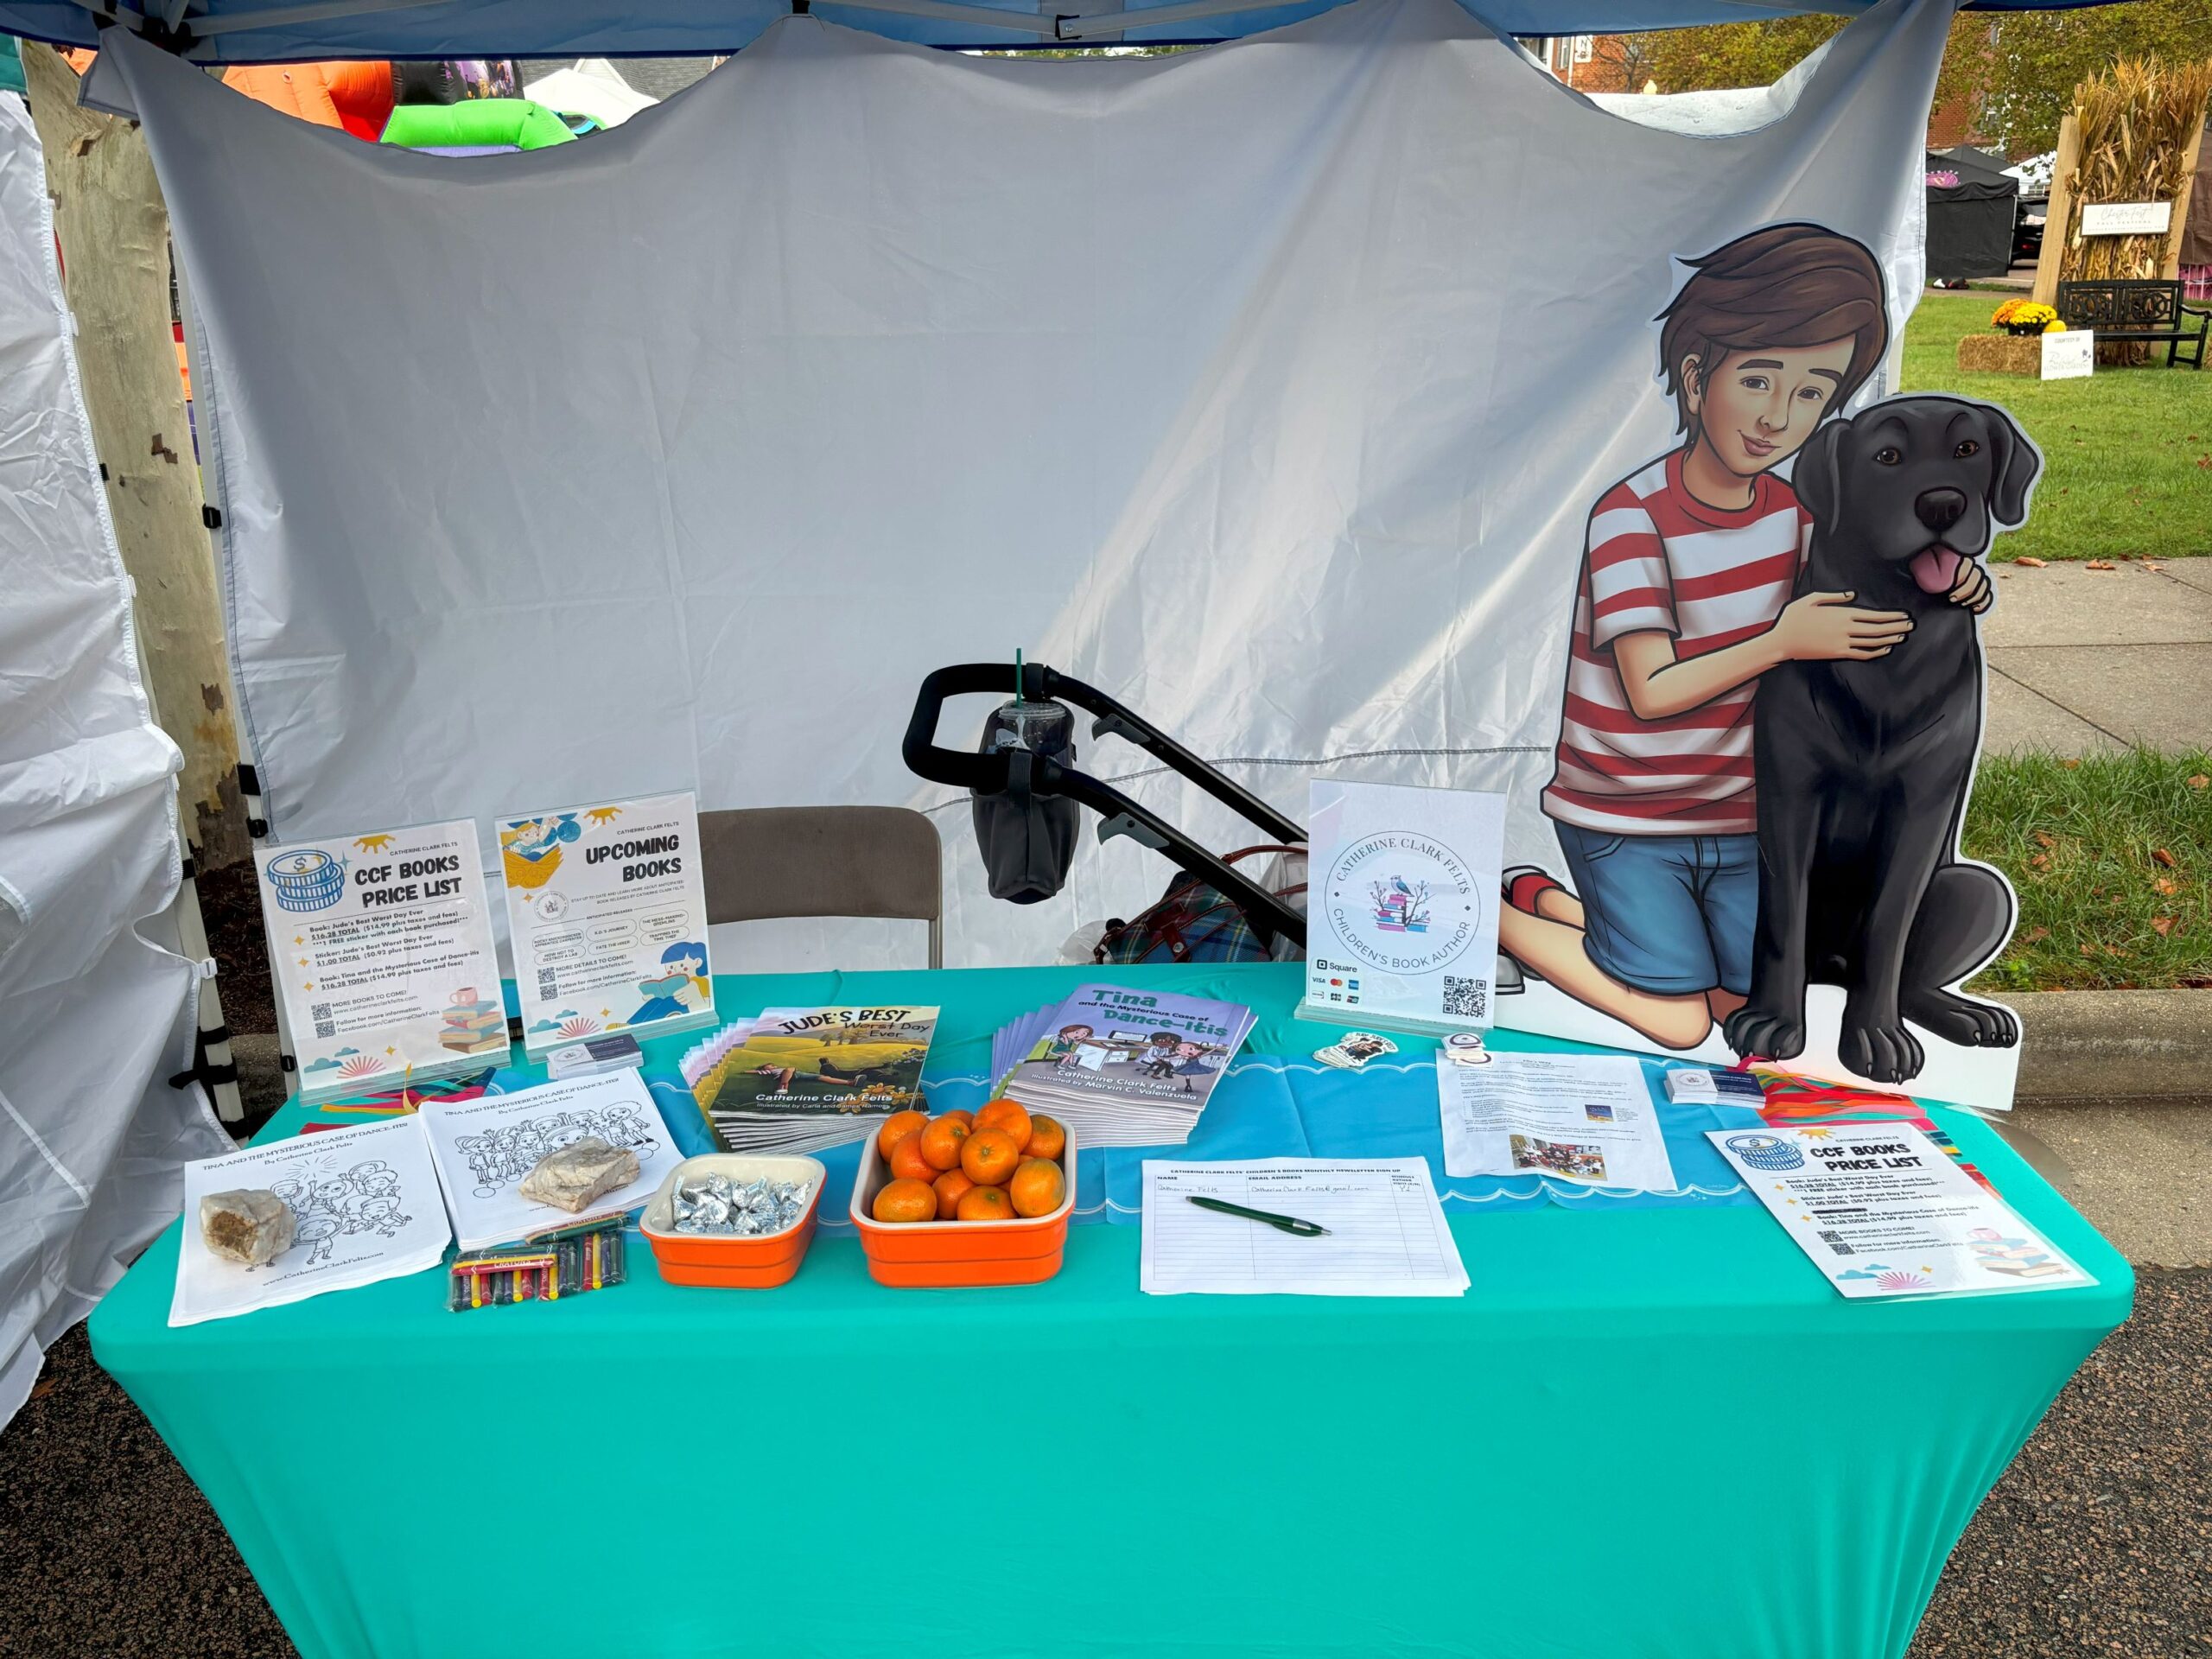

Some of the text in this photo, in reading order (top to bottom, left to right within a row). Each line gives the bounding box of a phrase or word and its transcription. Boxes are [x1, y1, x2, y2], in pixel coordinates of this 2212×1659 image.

[617, 826, 645, 835] CATHERINE
[389, 847, 421, 856] CATHERINE
[586, 835, 679, 864] UPCOMING
[355, 855, 459, 885] CCF BOOKS
[622, 857, 681, 882] BOOKS
[1337, 838, 1470, 895] CATHERINE CLARK FELTS
[362, 877, 461, 907] PRICE LIST
[311, 931, 336, 940] $16.28
[338, 927, 360, 936] TOTAL
[363, 922, 390, 932] ($14.99
[1334, 908, 1470, 968] CHILDREN'S BOOK AUTHOR
[315, 951, 340, 959] Sticker:
[316, 958, 337, 967] $1.00
[338, 954, 360, 963] TOTAL
[364, 949, 386, 959] ($0.92
[574, 959, 597, 968] DETAILS
[607, 954, 627, 962] COME!
[385, 961, 421, 971] Mysterious
[1330, 962, 1357, 972] Square
[321, 981, 346, 990] $16.28
[347, 977, 368, 986] TOTAL
[369, 971, 396, 982] ($14.99
[332, 1000, 350, 1008] MORE
[352, 996, 374, 1004] BOOKS
[385, 990, 406, 998] COME!
[1093, 990, 1157, 1007] Tina
[1117, 1005, 1169, 1016] Mysterious
[778, 1009, 910, 1035] JUDE'S BEST
[844, 1021, 930, 1032] Worst Day
[1104, 1010, 1228, 1037] Dance-Itis
[869, 1030, 903, 1038] Ever
[1031, 1072, 1071, 1083] Illustrated
[1085, 1081, 1122, 1091] Marvin
[1139, 1088, 1196, 1100] Valenzuela
[1057, 1070, 1176, 1091] Catherine Clark Felts
[1810, 1143, 1910, 1157] CCF BOOKS
[1825, 1156, 1922, 1171] PRICE LIST
